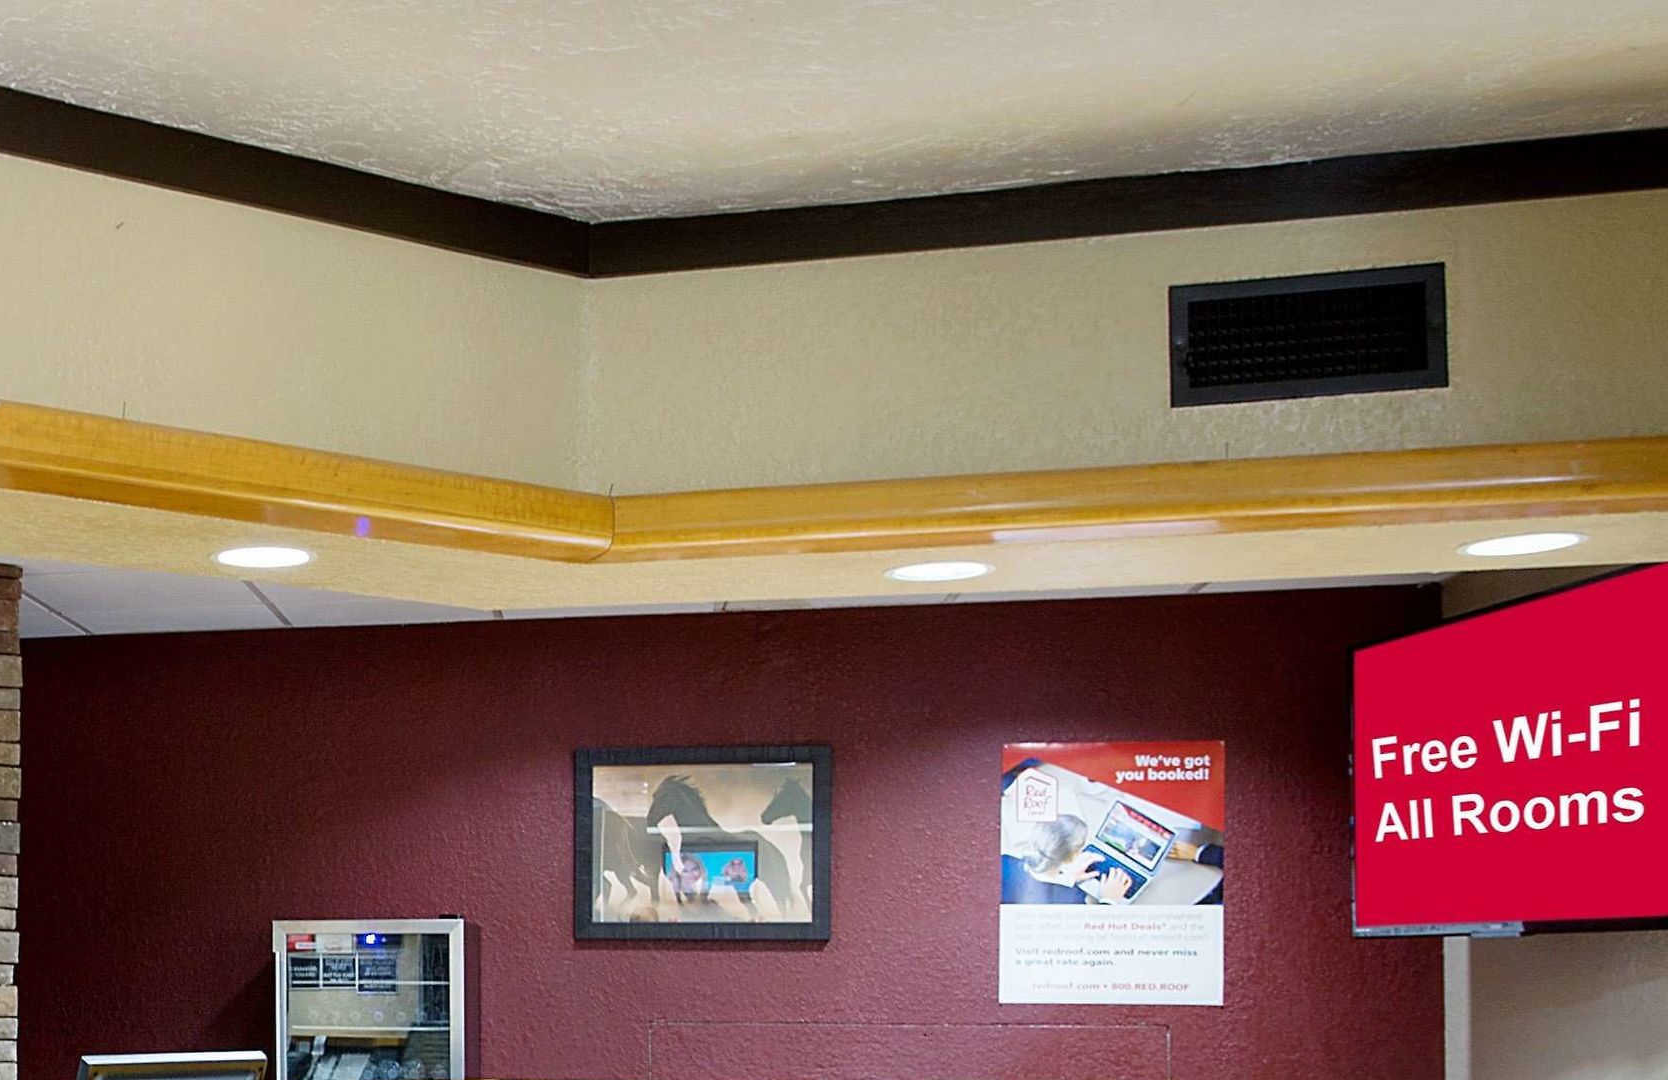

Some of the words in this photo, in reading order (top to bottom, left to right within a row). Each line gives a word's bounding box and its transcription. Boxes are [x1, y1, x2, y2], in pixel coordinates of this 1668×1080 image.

[1371, 733, 1478, 779] Free
[1492, 698, 1641, 763] Wi-Fi
[1135, 754, 1180, 767] We've
[1185, 754, 1211, 770] got
[1115, 770, 1144, 784] you
[1147, 768, 1210, 781] booked!
[1374, 797, 1434, 843] All
[1451, 786, 1645, 836] Rooms
[1113, 948, 1135, 956] and
[1172, 948, 1198, 957] miss
